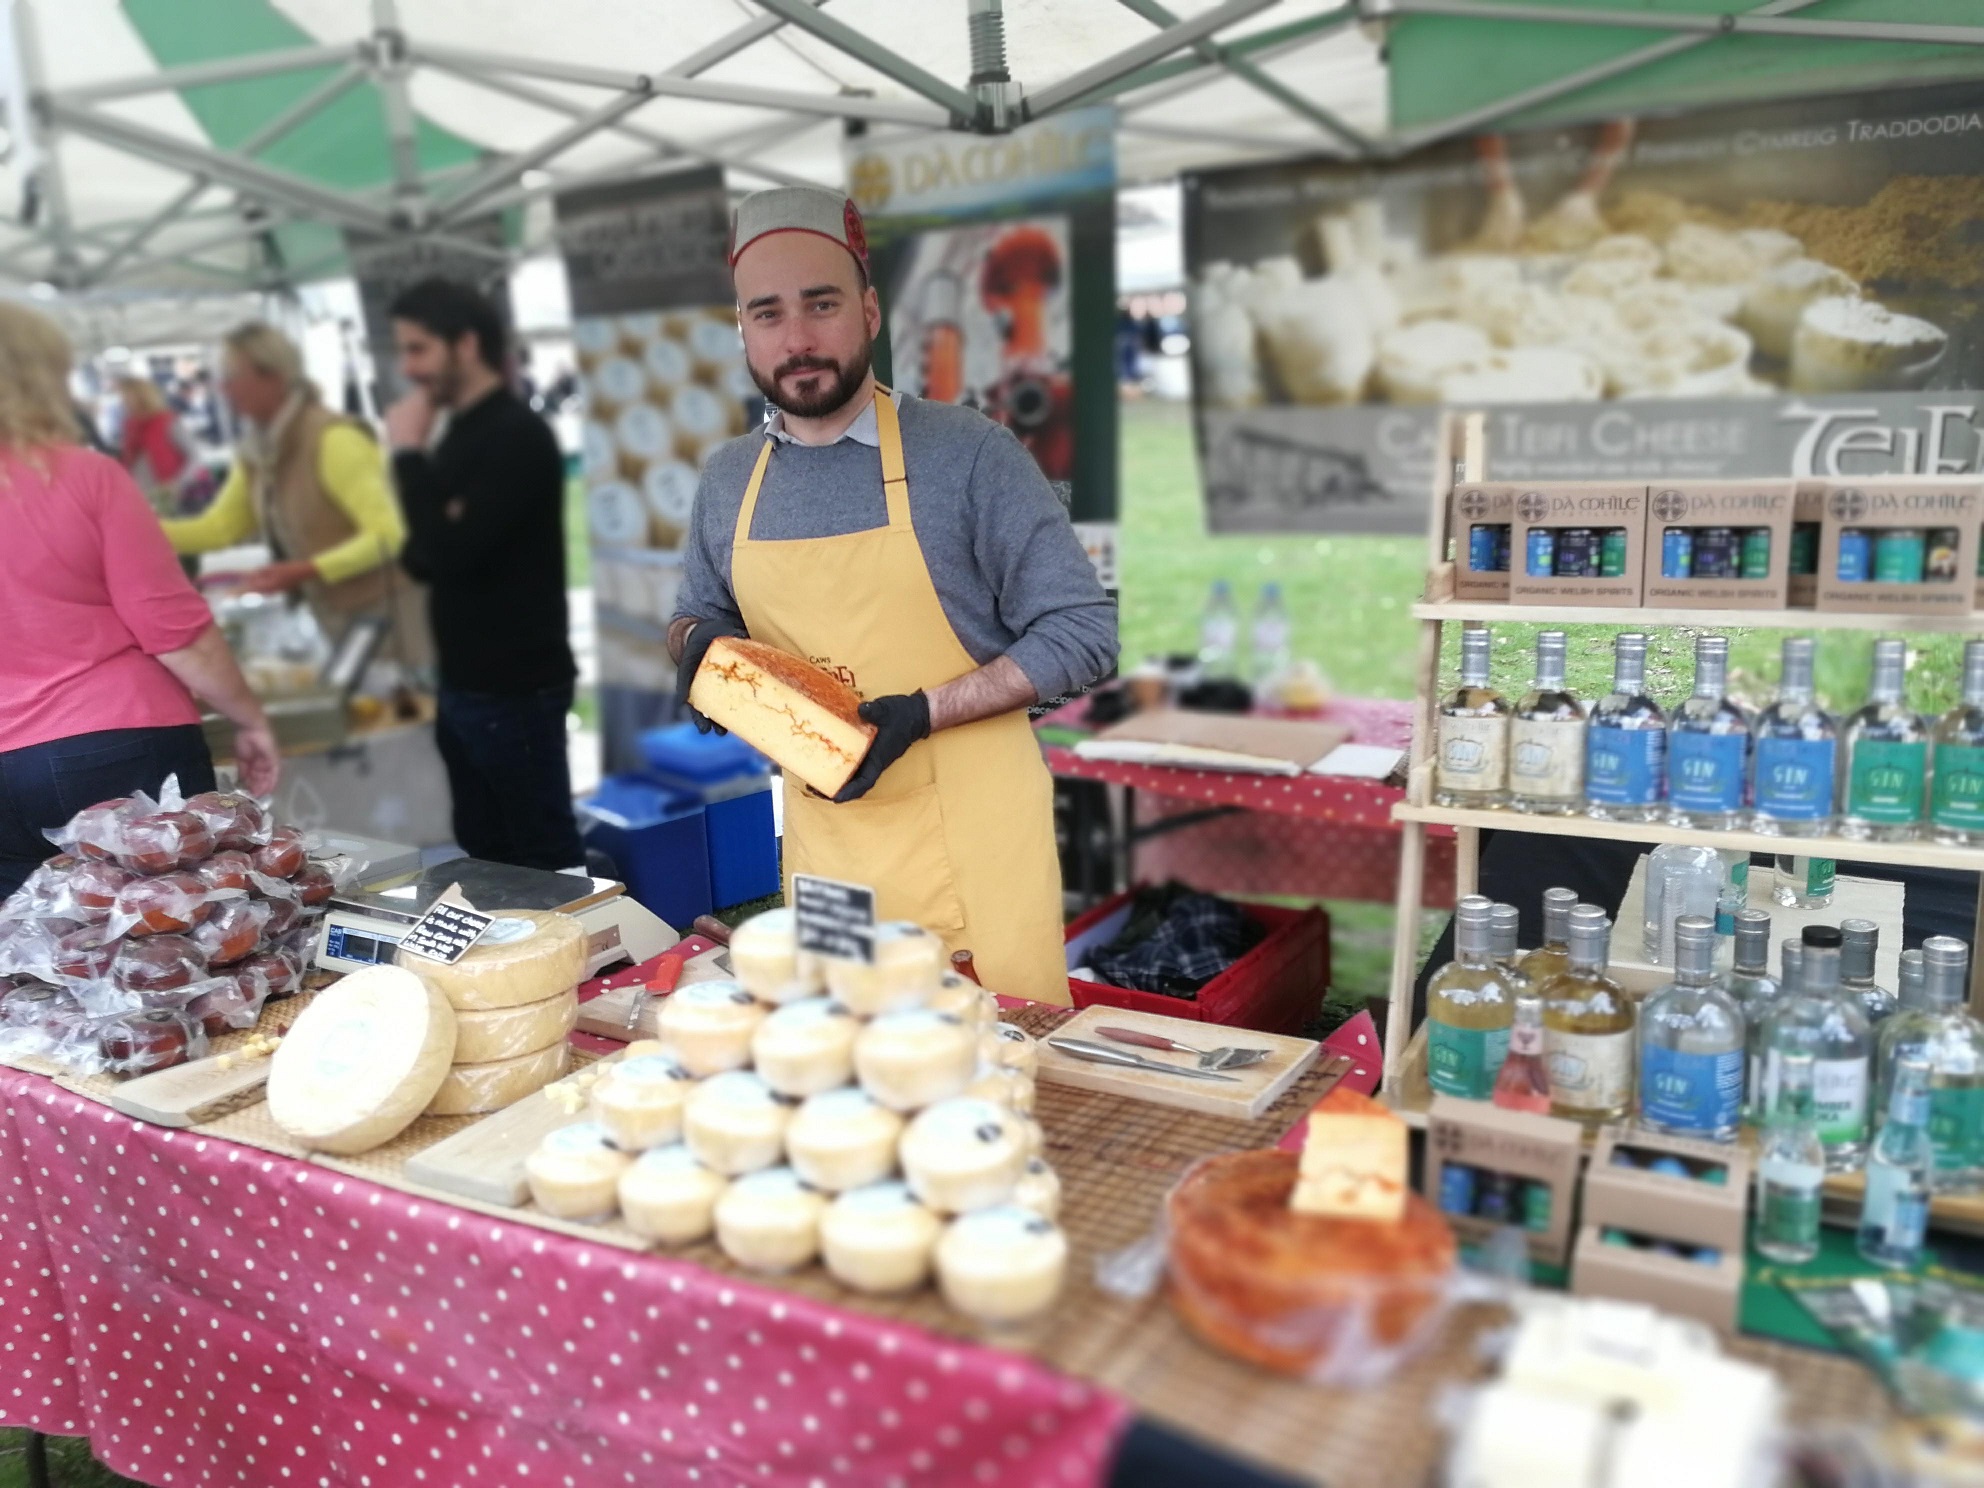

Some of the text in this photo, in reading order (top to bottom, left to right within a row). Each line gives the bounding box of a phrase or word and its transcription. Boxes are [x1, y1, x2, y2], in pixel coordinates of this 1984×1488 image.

[1515, 586, 1633, 596] ORGANIC WELSH SPIRITS
[1650, 589, 1694, 597] ORGANIC
[1592, 752, 1619, 770] GIN
[1682, 758, 1716, 777] GIN
[1773, 765, 1809, 784] GIN
[1869, 770, 1904, 789] GIN
[1948, 775, 1984, 795] GIN
[433, 905, 449, 916] All
[434, 919, 458, 933] made
[1656, 1072, 1687, 1095] GIN
